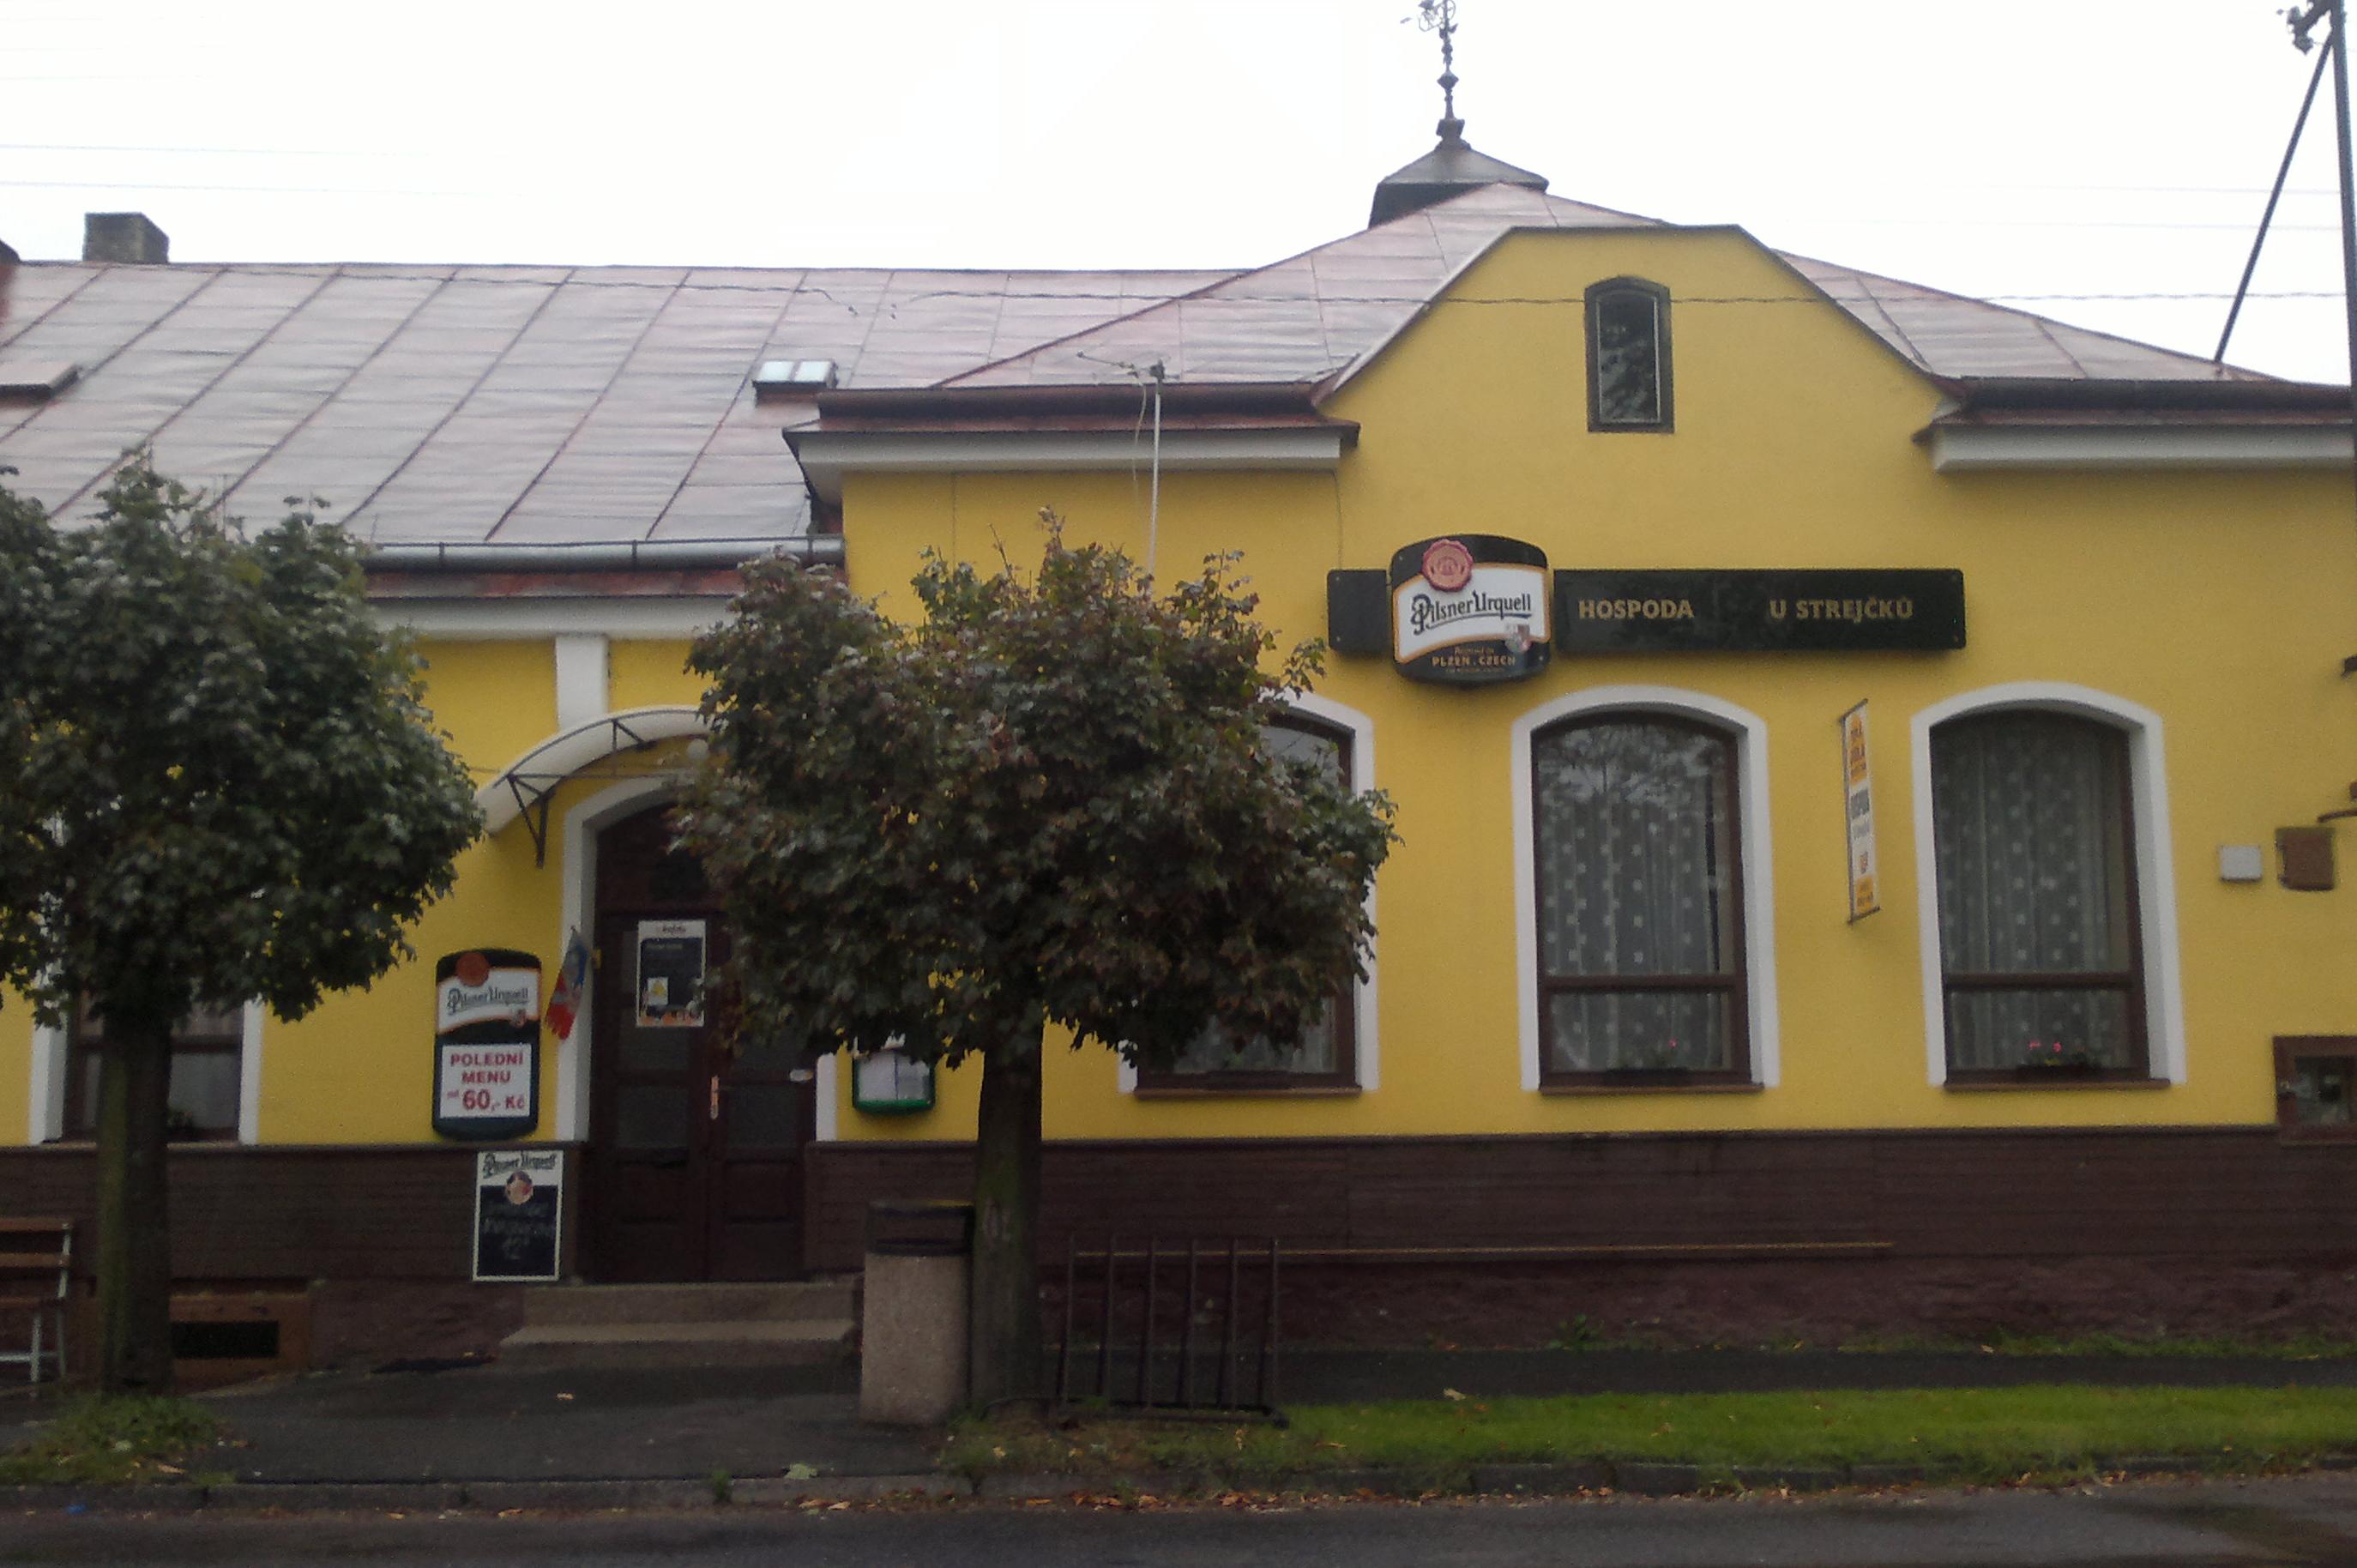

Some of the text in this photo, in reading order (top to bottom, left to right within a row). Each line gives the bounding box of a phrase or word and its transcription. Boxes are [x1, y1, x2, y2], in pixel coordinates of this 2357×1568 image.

[1410, 590, 1532, 635] Pilsner Urquell
[1578, 599, 1695, 619] HOSPODA
[1769, 600, 1787, 619] U
[447, 986, 528, 1016] Pilsner Urquell
[450, 1051, 523, 1066] POLEDNÍ
[462, 1070, 511, 1084] MENU
